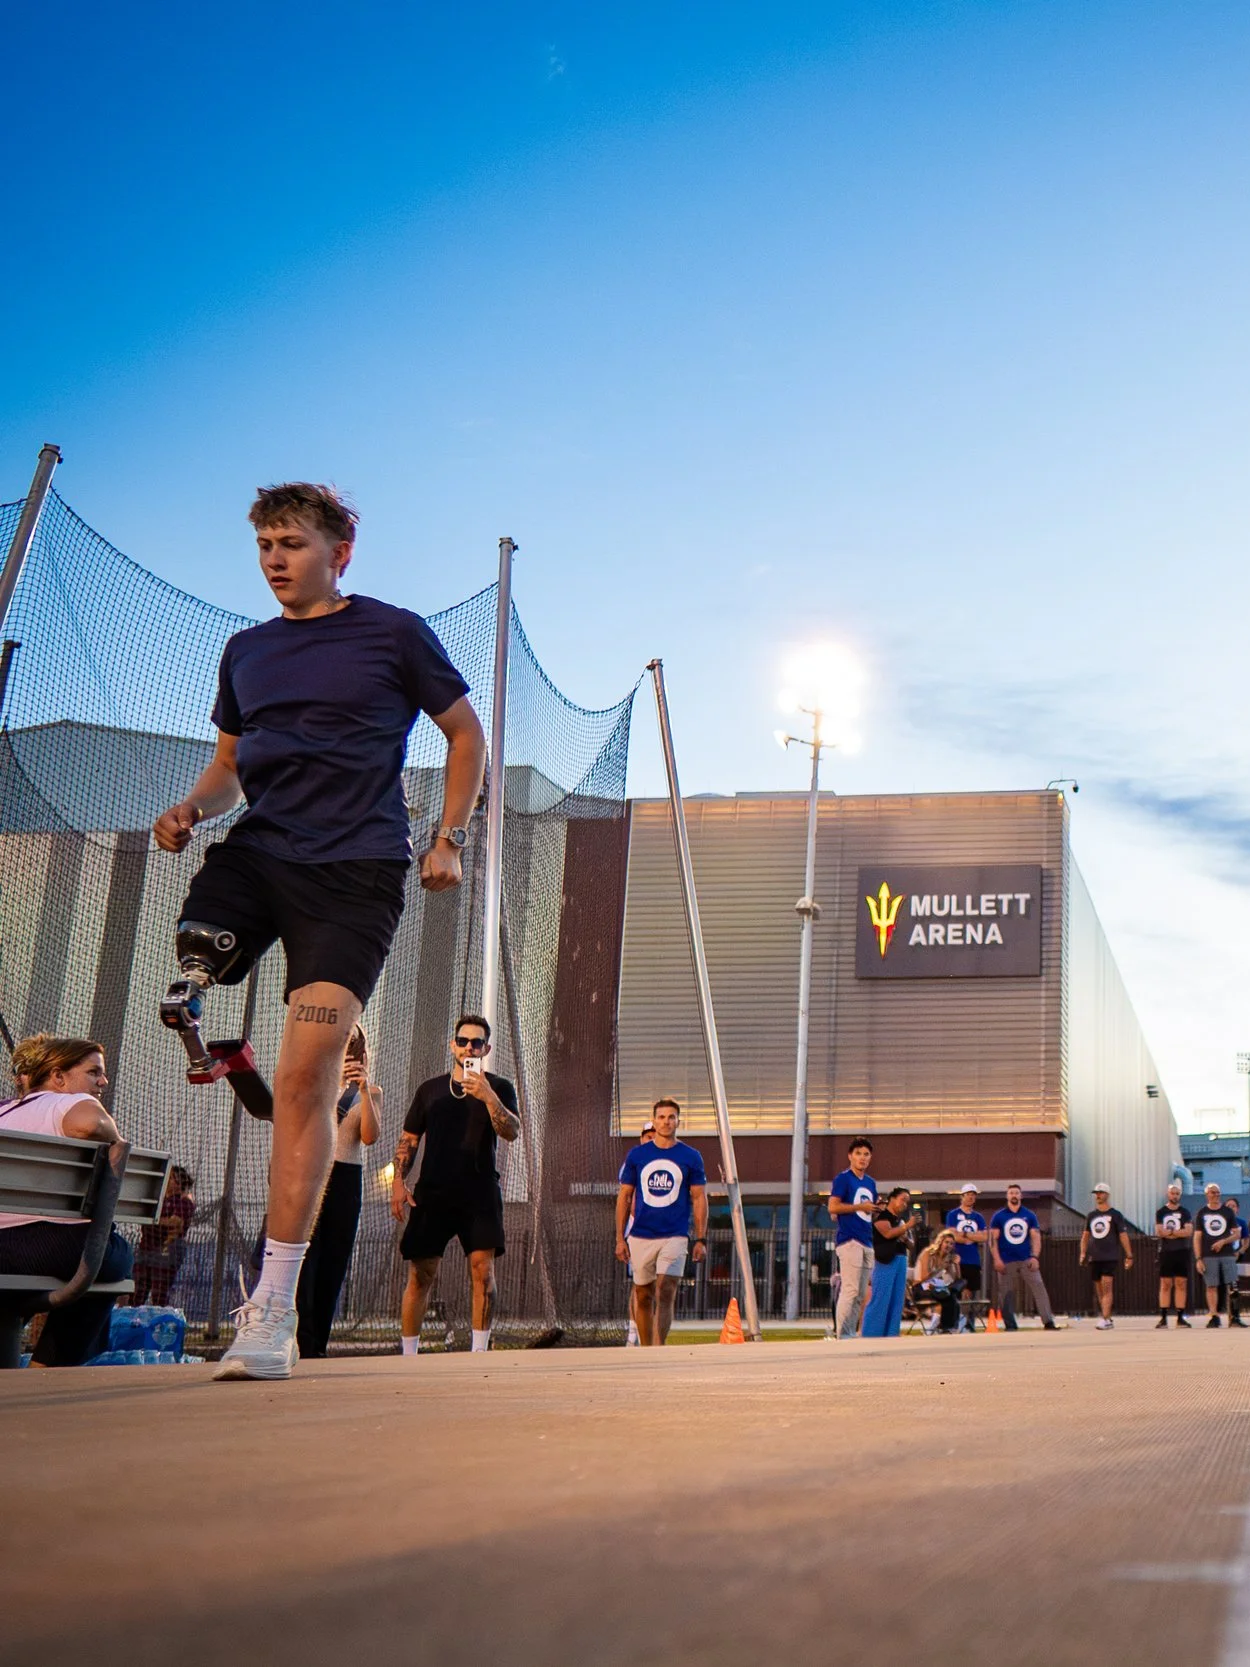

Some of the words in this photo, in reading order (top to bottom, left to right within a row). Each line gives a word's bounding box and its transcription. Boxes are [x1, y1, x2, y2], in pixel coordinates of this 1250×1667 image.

[910, 893, 1031, 917] MULLETT
[908, 923, 1004, 946] ARENA
[296, 1004, 338, 1025] 2006
